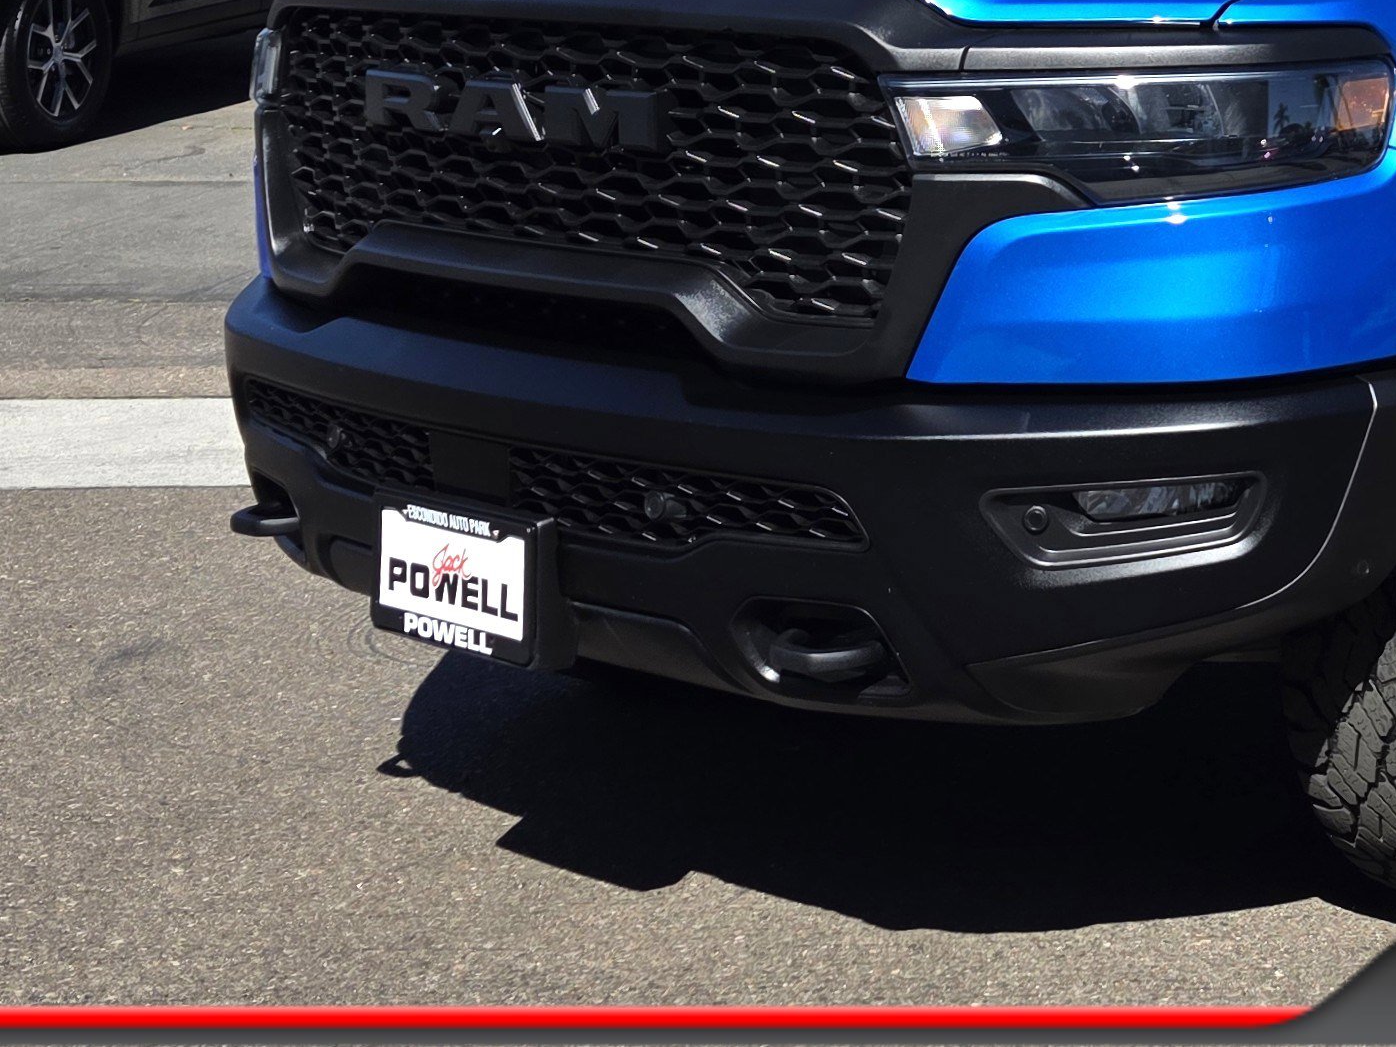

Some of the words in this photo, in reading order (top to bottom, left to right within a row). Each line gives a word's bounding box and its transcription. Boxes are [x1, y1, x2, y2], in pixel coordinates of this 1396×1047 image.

[365, 68, 660, 150] RAM
[448, 514, 470, 533] AUTO
[469, 518, 491, 537] PARK
[431, 543, 471, 587] Jack
[388, 556, 518, 622] POWELL
[403, 612, 493, 656] POWELL
